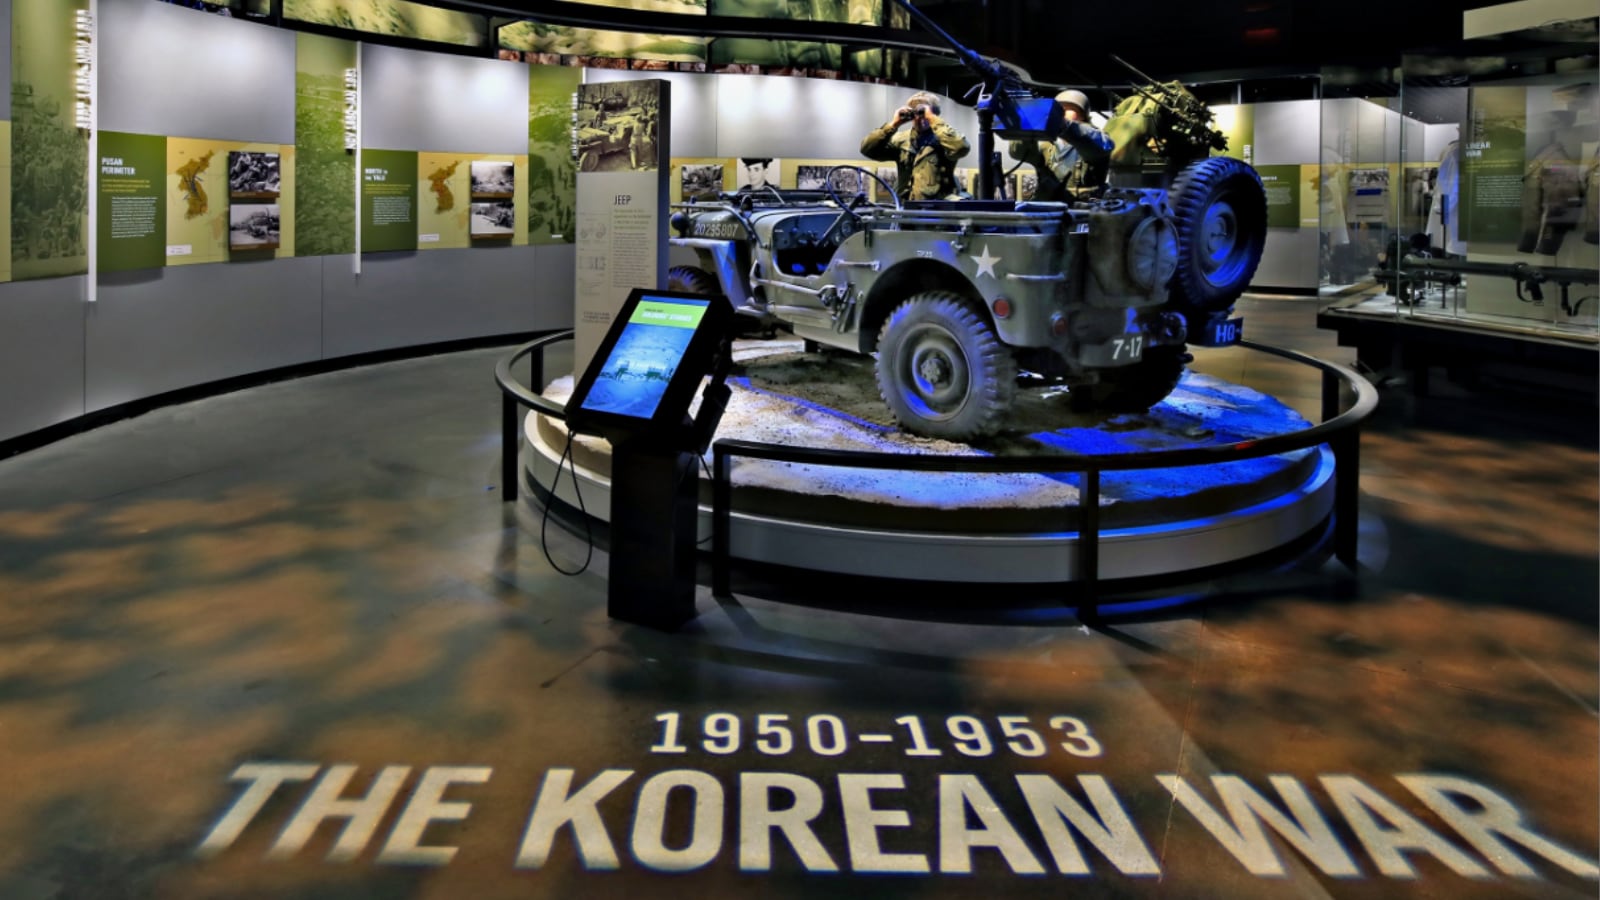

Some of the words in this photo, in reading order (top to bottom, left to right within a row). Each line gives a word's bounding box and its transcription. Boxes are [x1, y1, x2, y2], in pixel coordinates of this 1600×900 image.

[101, 157, 123, 166] PUSAN
[101, 167, 136, 175] PERIMETER
[614, 195, 631, 205] JEEP
[650, 712, 1104, 757] 1950-1953
[195, 762, 494, 865] THE
[514, 768, 1163, 876] KOREAN
[1155, 774, 1600, 879] WAR
